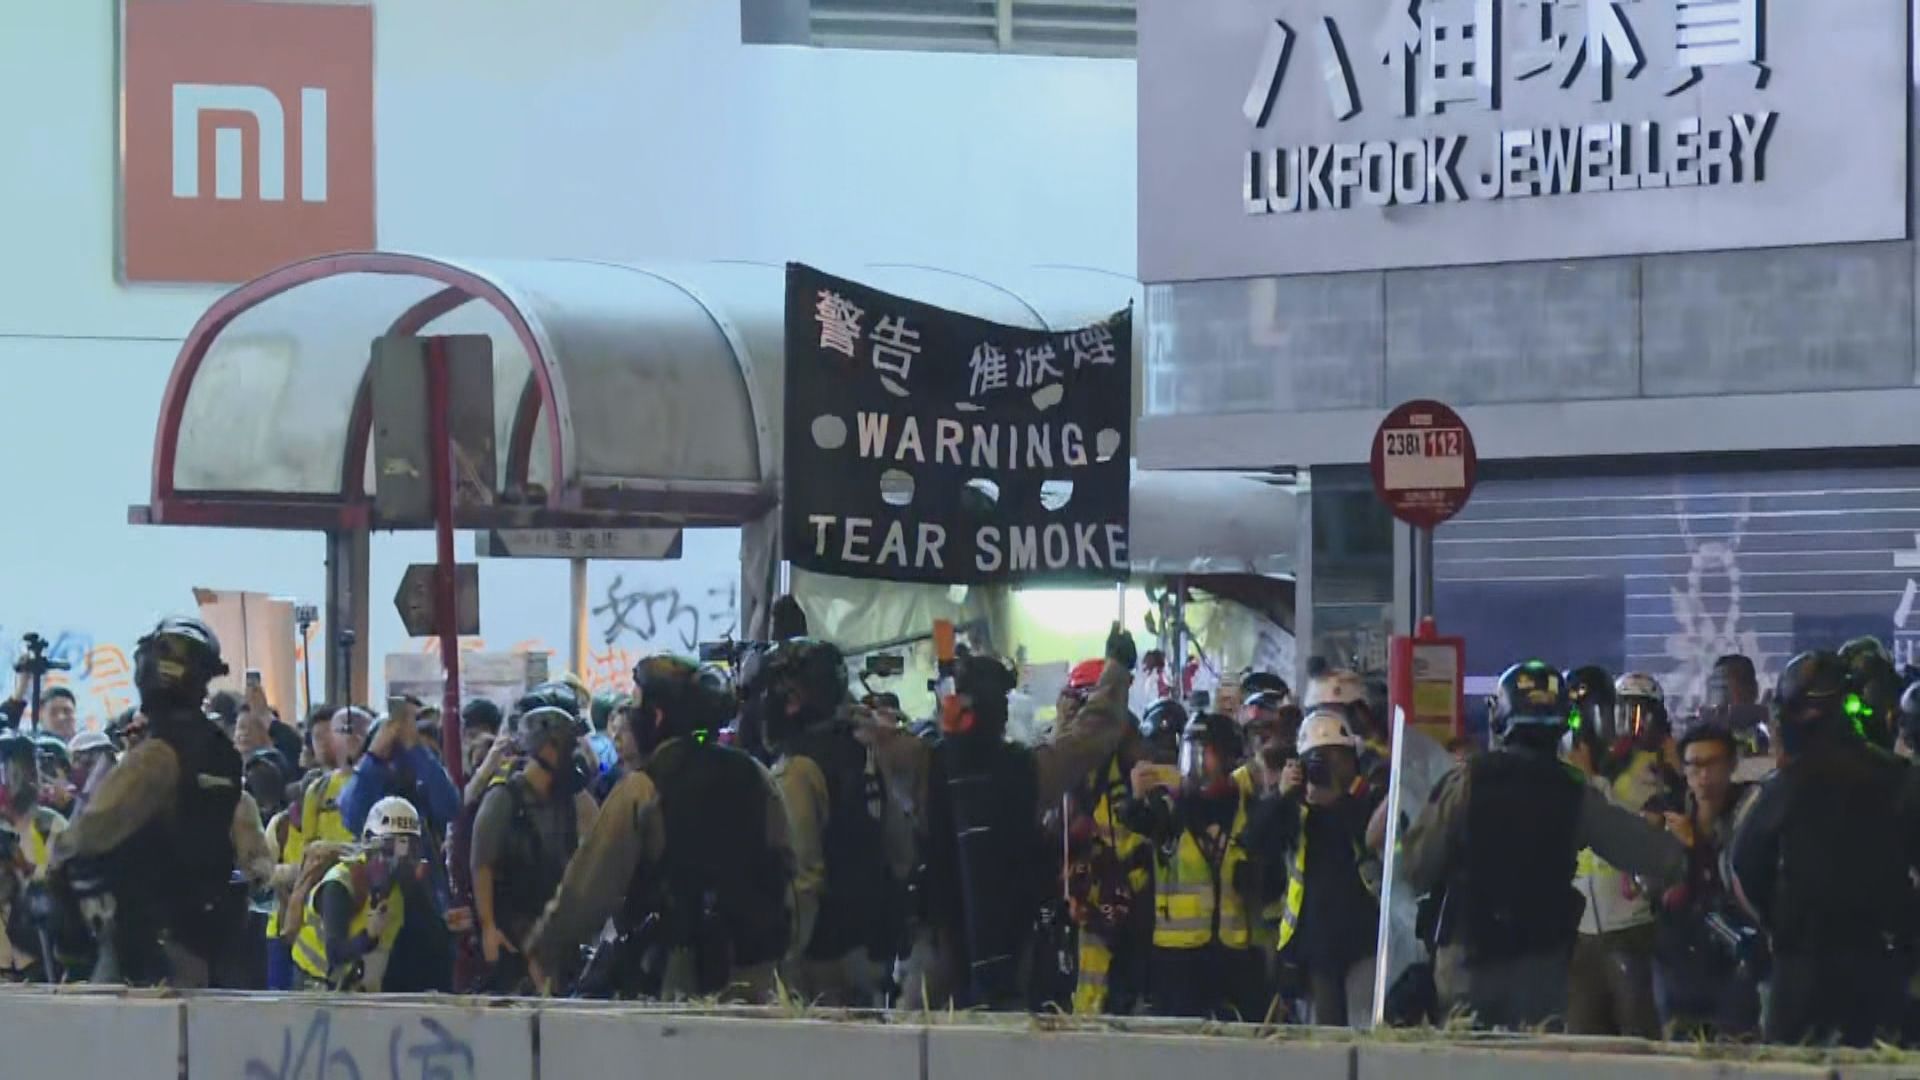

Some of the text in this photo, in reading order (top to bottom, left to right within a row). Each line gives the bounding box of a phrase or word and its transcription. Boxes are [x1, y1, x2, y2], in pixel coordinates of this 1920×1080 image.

[1243, 111, 1778, 214] LUKFOOK JEWELLERY
[814, 289, 922, 379] 警告
[857, 411, 1088, 470] WARNING
[1425, 431, 1458, 456] 112
[809, 514, 1129, 571] TEAR SMOKE
